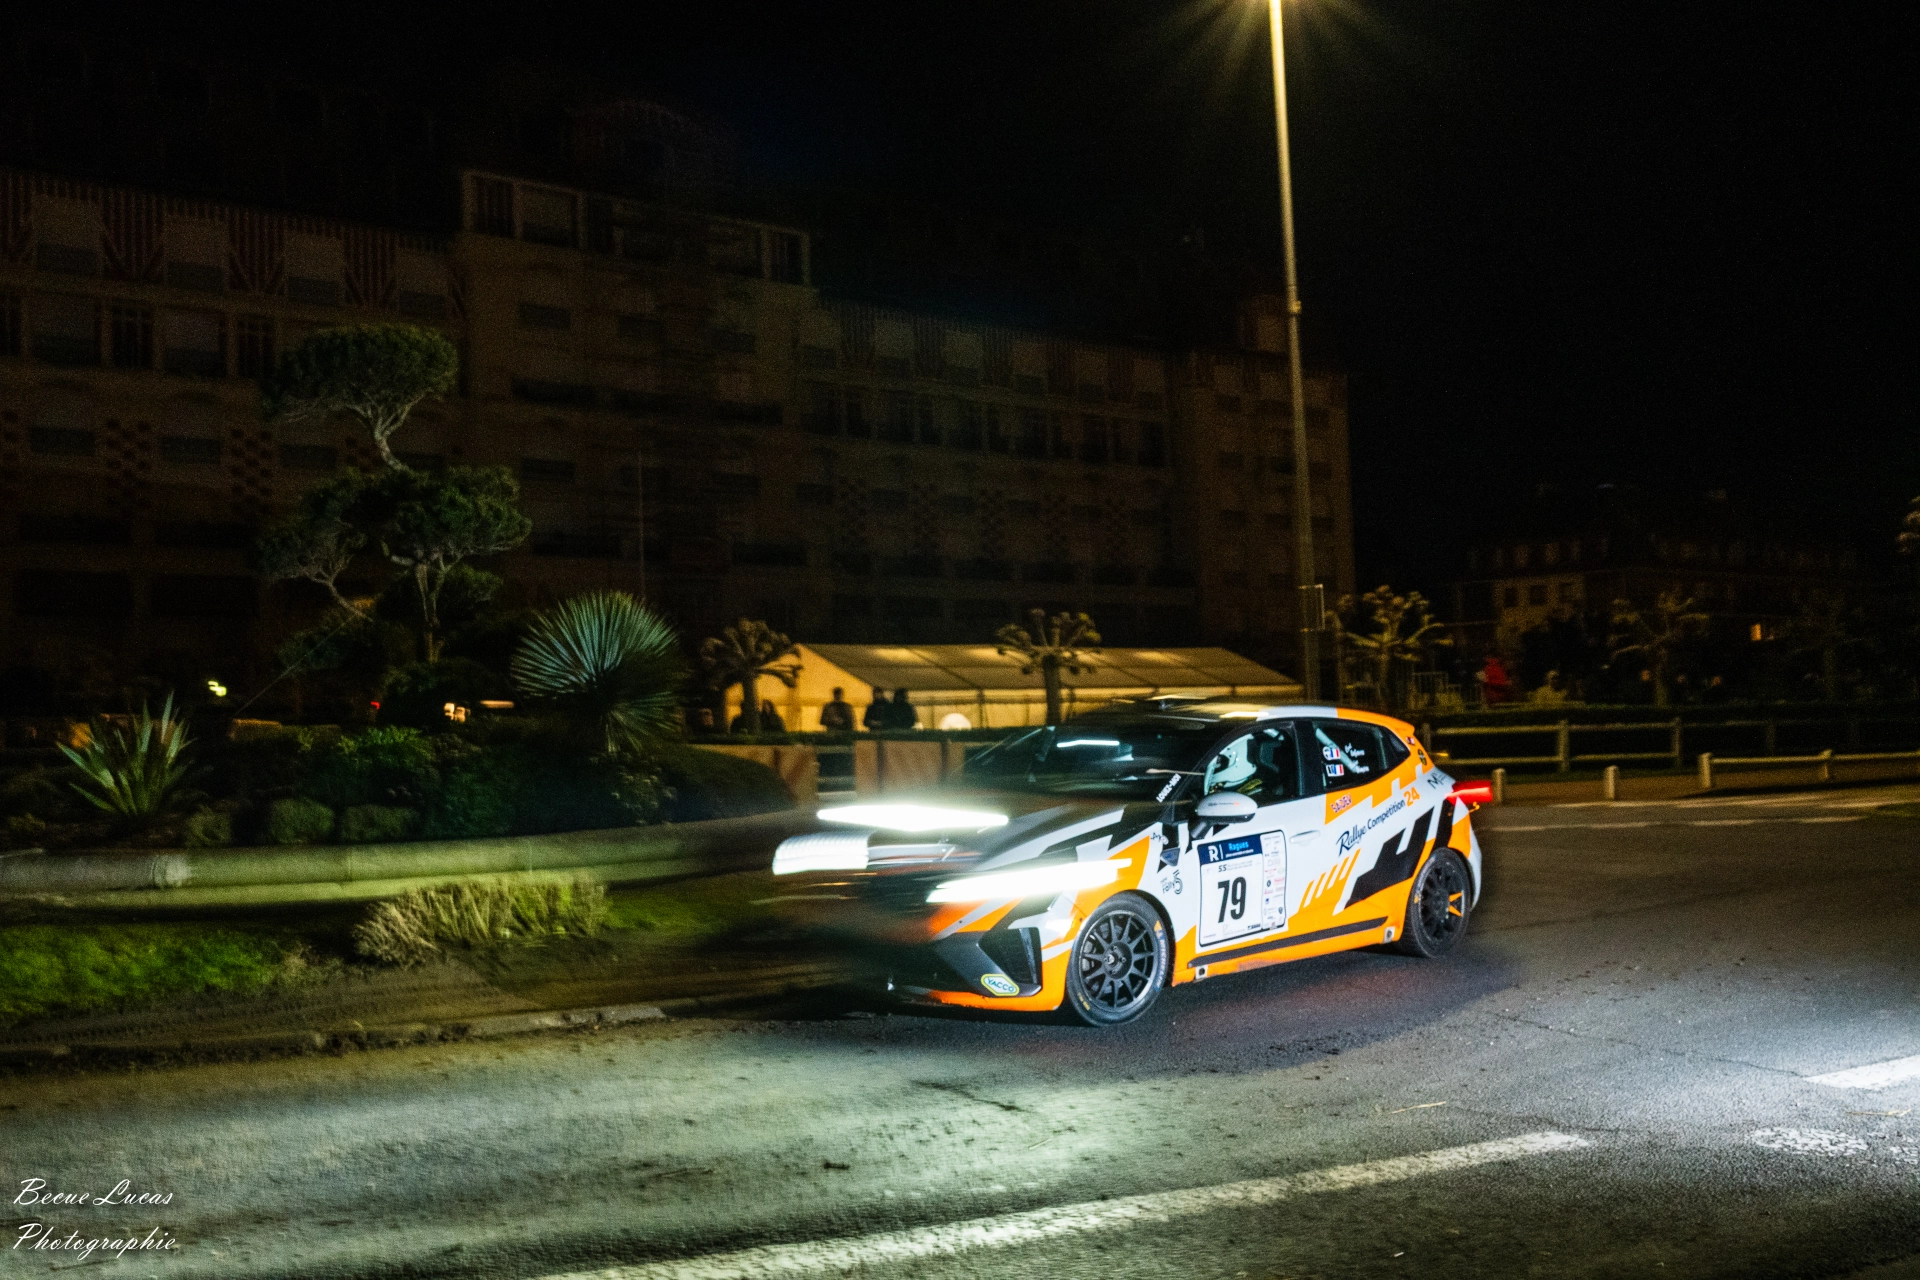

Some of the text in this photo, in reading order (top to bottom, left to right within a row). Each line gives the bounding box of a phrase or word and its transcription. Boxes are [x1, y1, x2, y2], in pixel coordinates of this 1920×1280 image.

[1331, 793, 1352, 813] SADEV
[1336, 825, 1367, 857] Rallye
[1404, 787, 1420, 807] 24
[1217, 876, 1247, 924] 79
[987, 977, 1015, 993] YACCO
